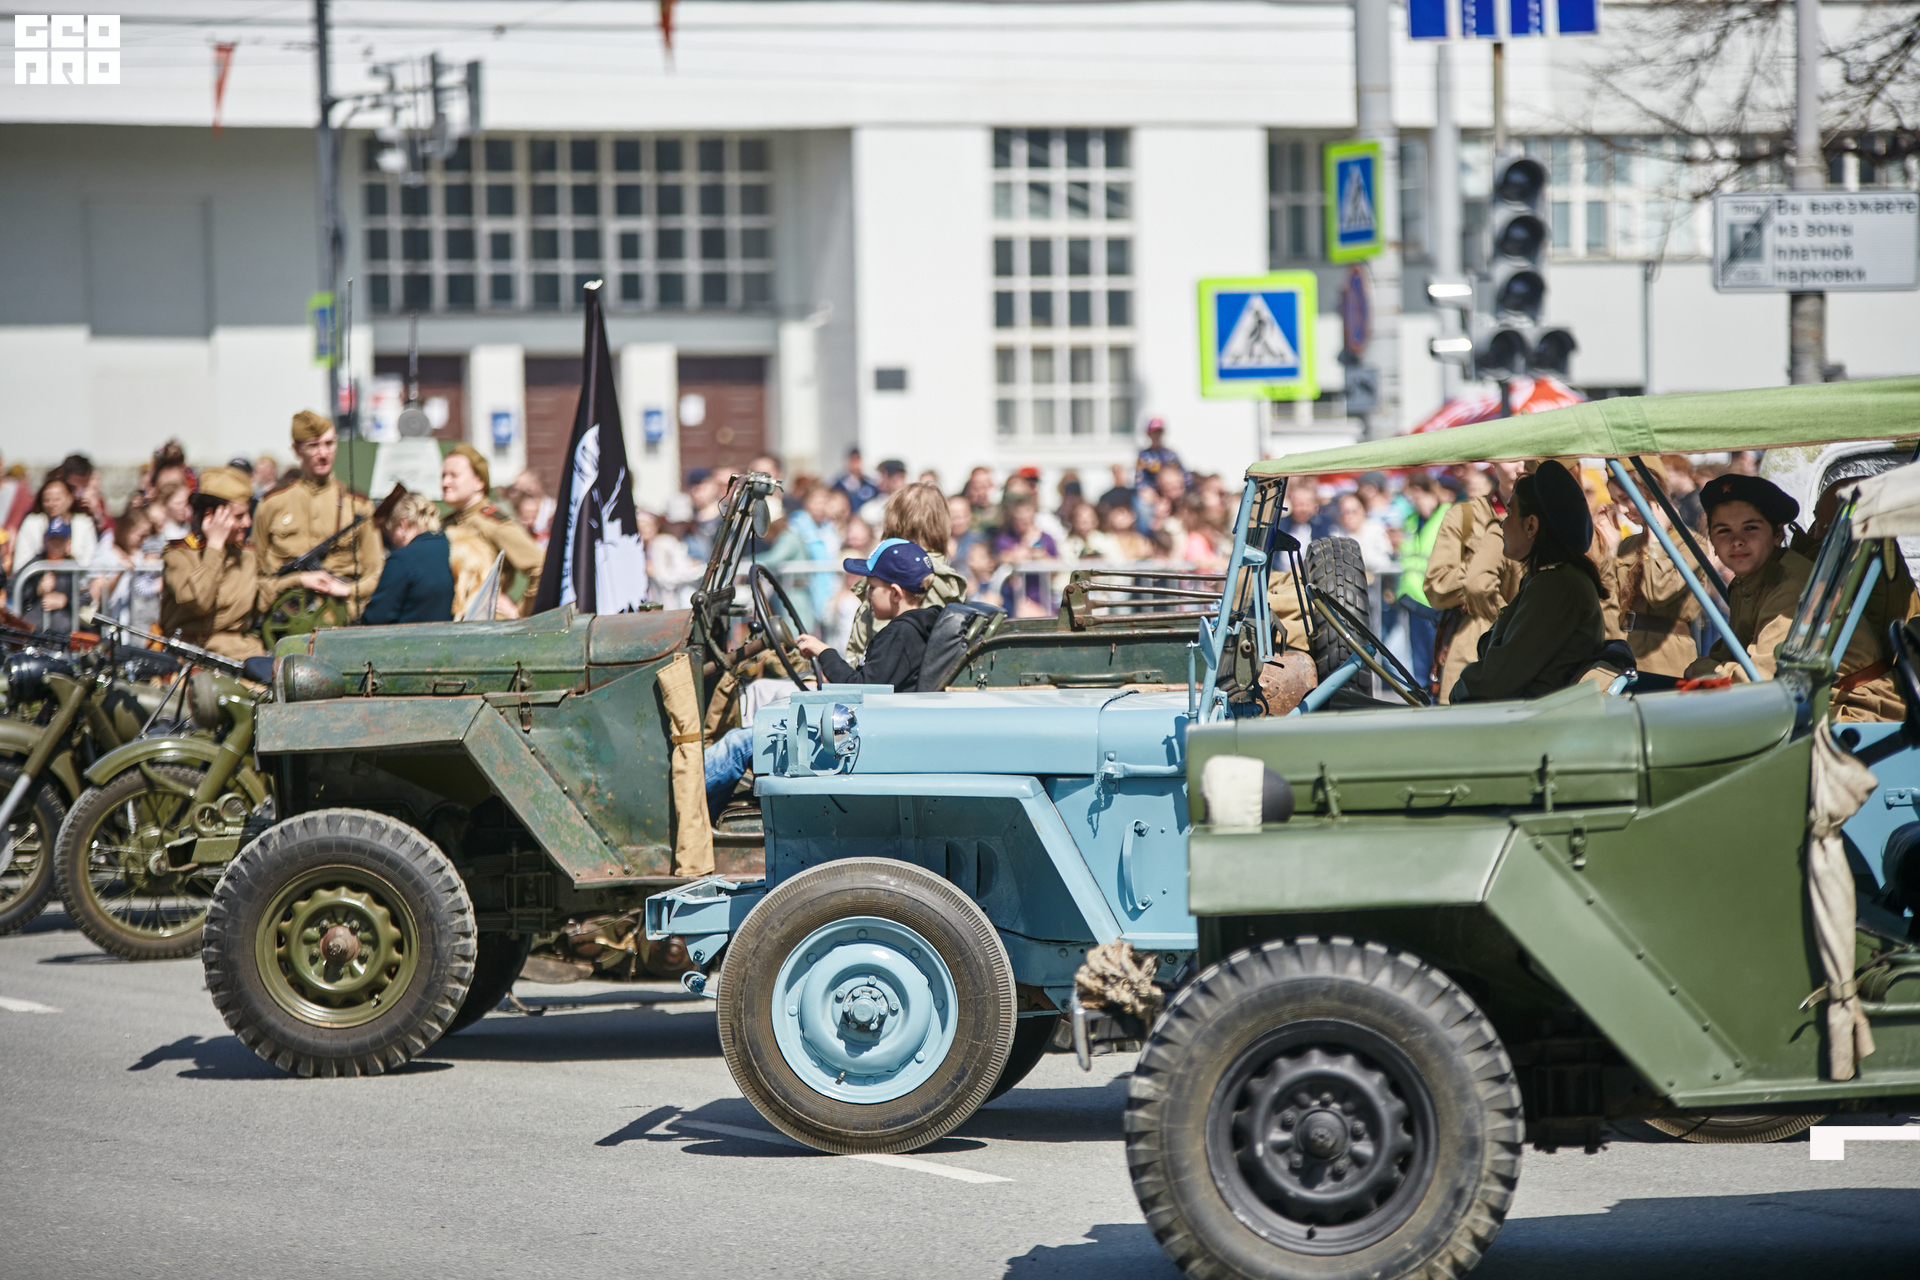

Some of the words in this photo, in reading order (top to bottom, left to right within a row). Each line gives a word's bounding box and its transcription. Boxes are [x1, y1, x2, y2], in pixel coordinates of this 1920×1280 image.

[1777, 199, 1802, 215] Вы
[1810, 200, 1917, 215] выезжаете
[1777, 224, 1799, 237] из
[1806, 224, 1853, 237] зоны
[1777, 243, 1853, 261] платной
[1777, 268, 1866, 287] парковки
